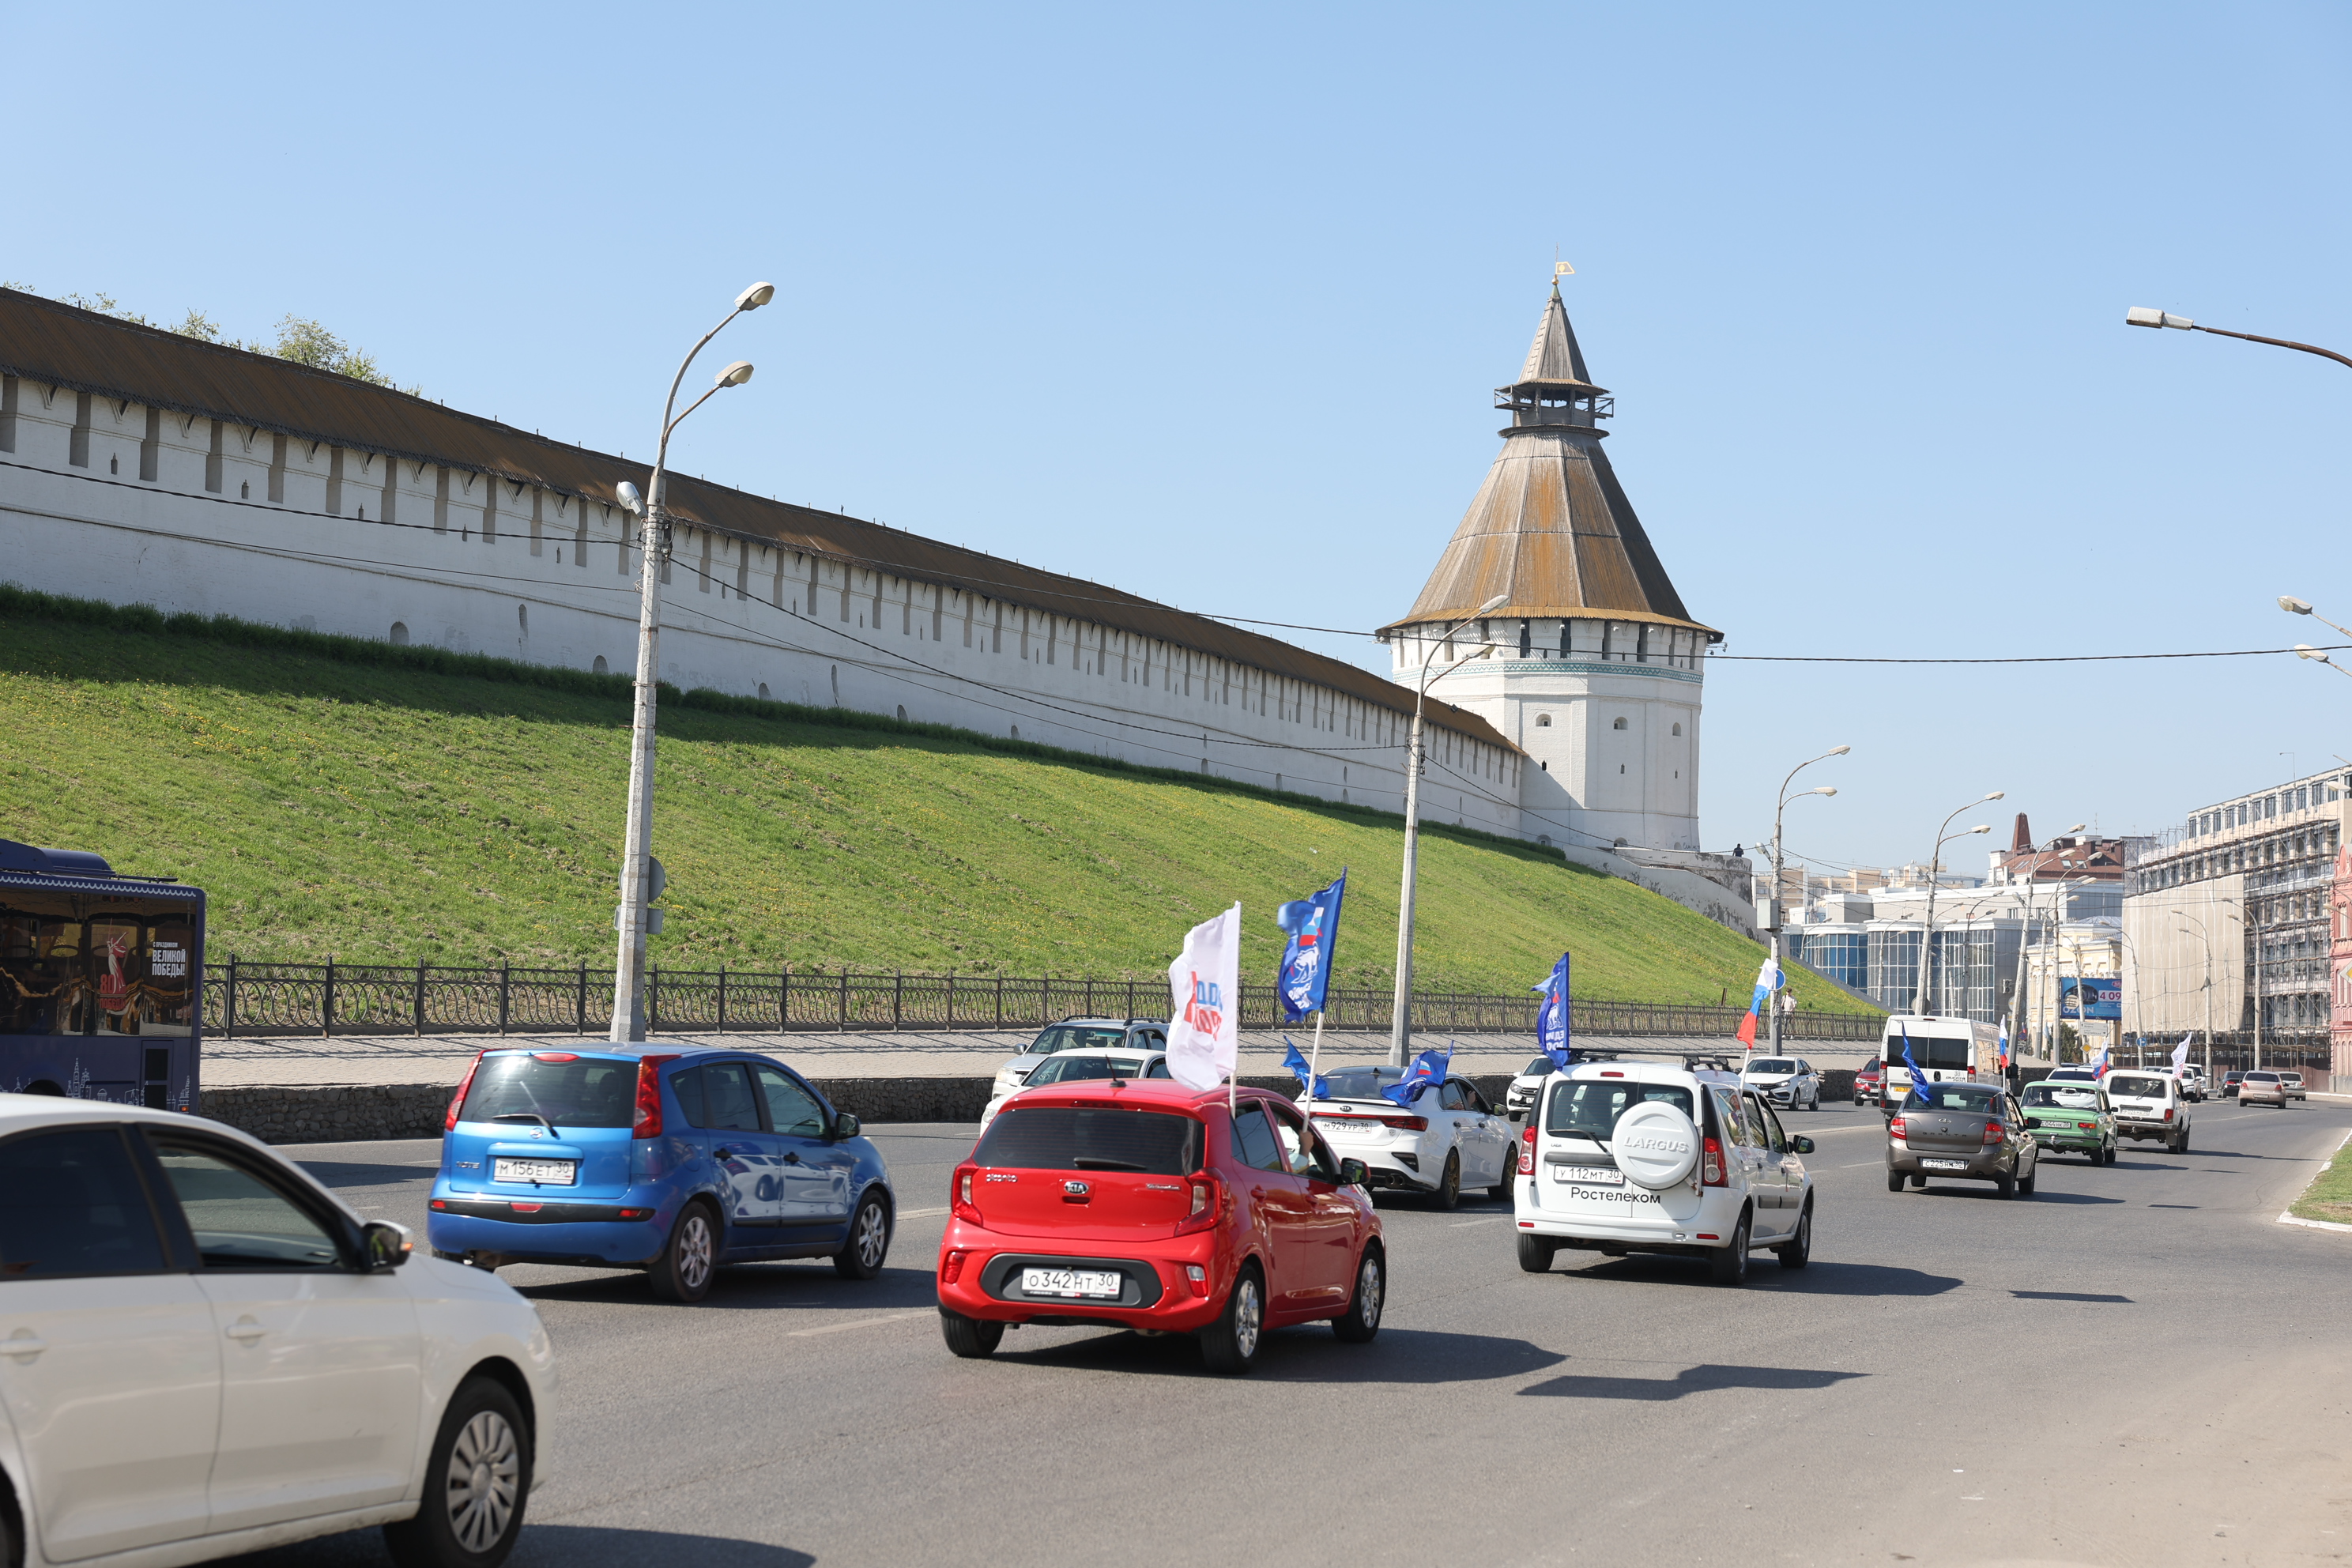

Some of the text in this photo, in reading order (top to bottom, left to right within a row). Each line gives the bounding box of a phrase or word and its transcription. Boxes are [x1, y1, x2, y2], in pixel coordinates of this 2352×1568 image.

[152, 948, 187, 963] ВЕЛИКОЙ
[152, 963, 186, 978] ПОБЕДЫ!
[100, 974, 115, 994] 80
[1624, 1136, 1689, 1152] LARGUS
[556, 1162, 570, 1174] 30
[1608, 1169, 1619, 1178] 30
[1067, 1184, 1084, 1193] KIA
[1570, 1186, 1660, 1204] Ростелеком
[1098, 1273, 1114, 1287] 30
